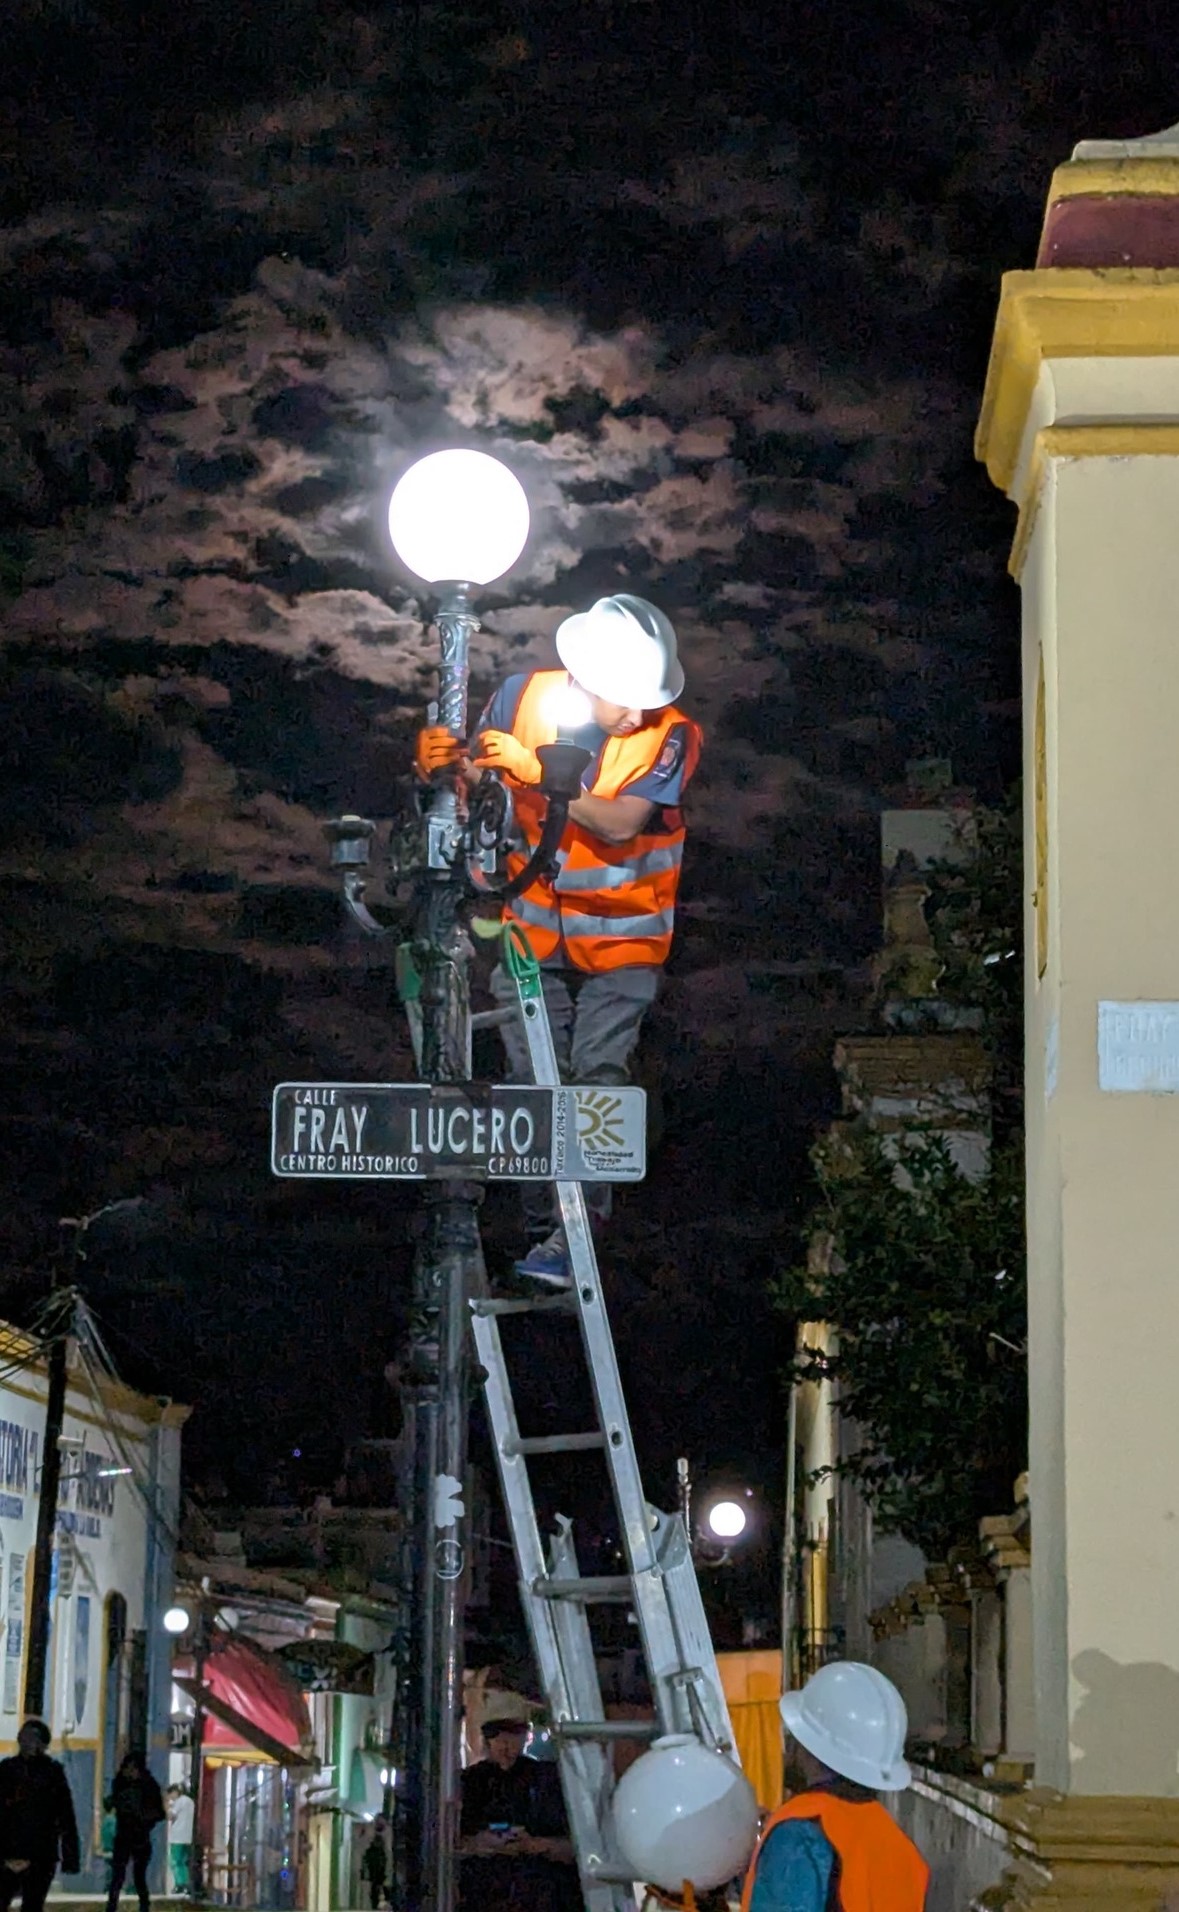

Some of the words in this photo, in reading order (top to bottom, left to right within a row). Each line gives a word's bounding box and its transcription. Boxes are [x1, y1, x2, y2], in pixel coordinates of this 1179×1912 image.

[294, 1089, 336, 1105] CALLE
[294, 1106, 368, 1153] FRAY
[410, 1107, 534, 1155] LUCERO
[280, 1154, 337, 1171] CENTRO
[341, 1155, 418, 1173] HISTORICO
